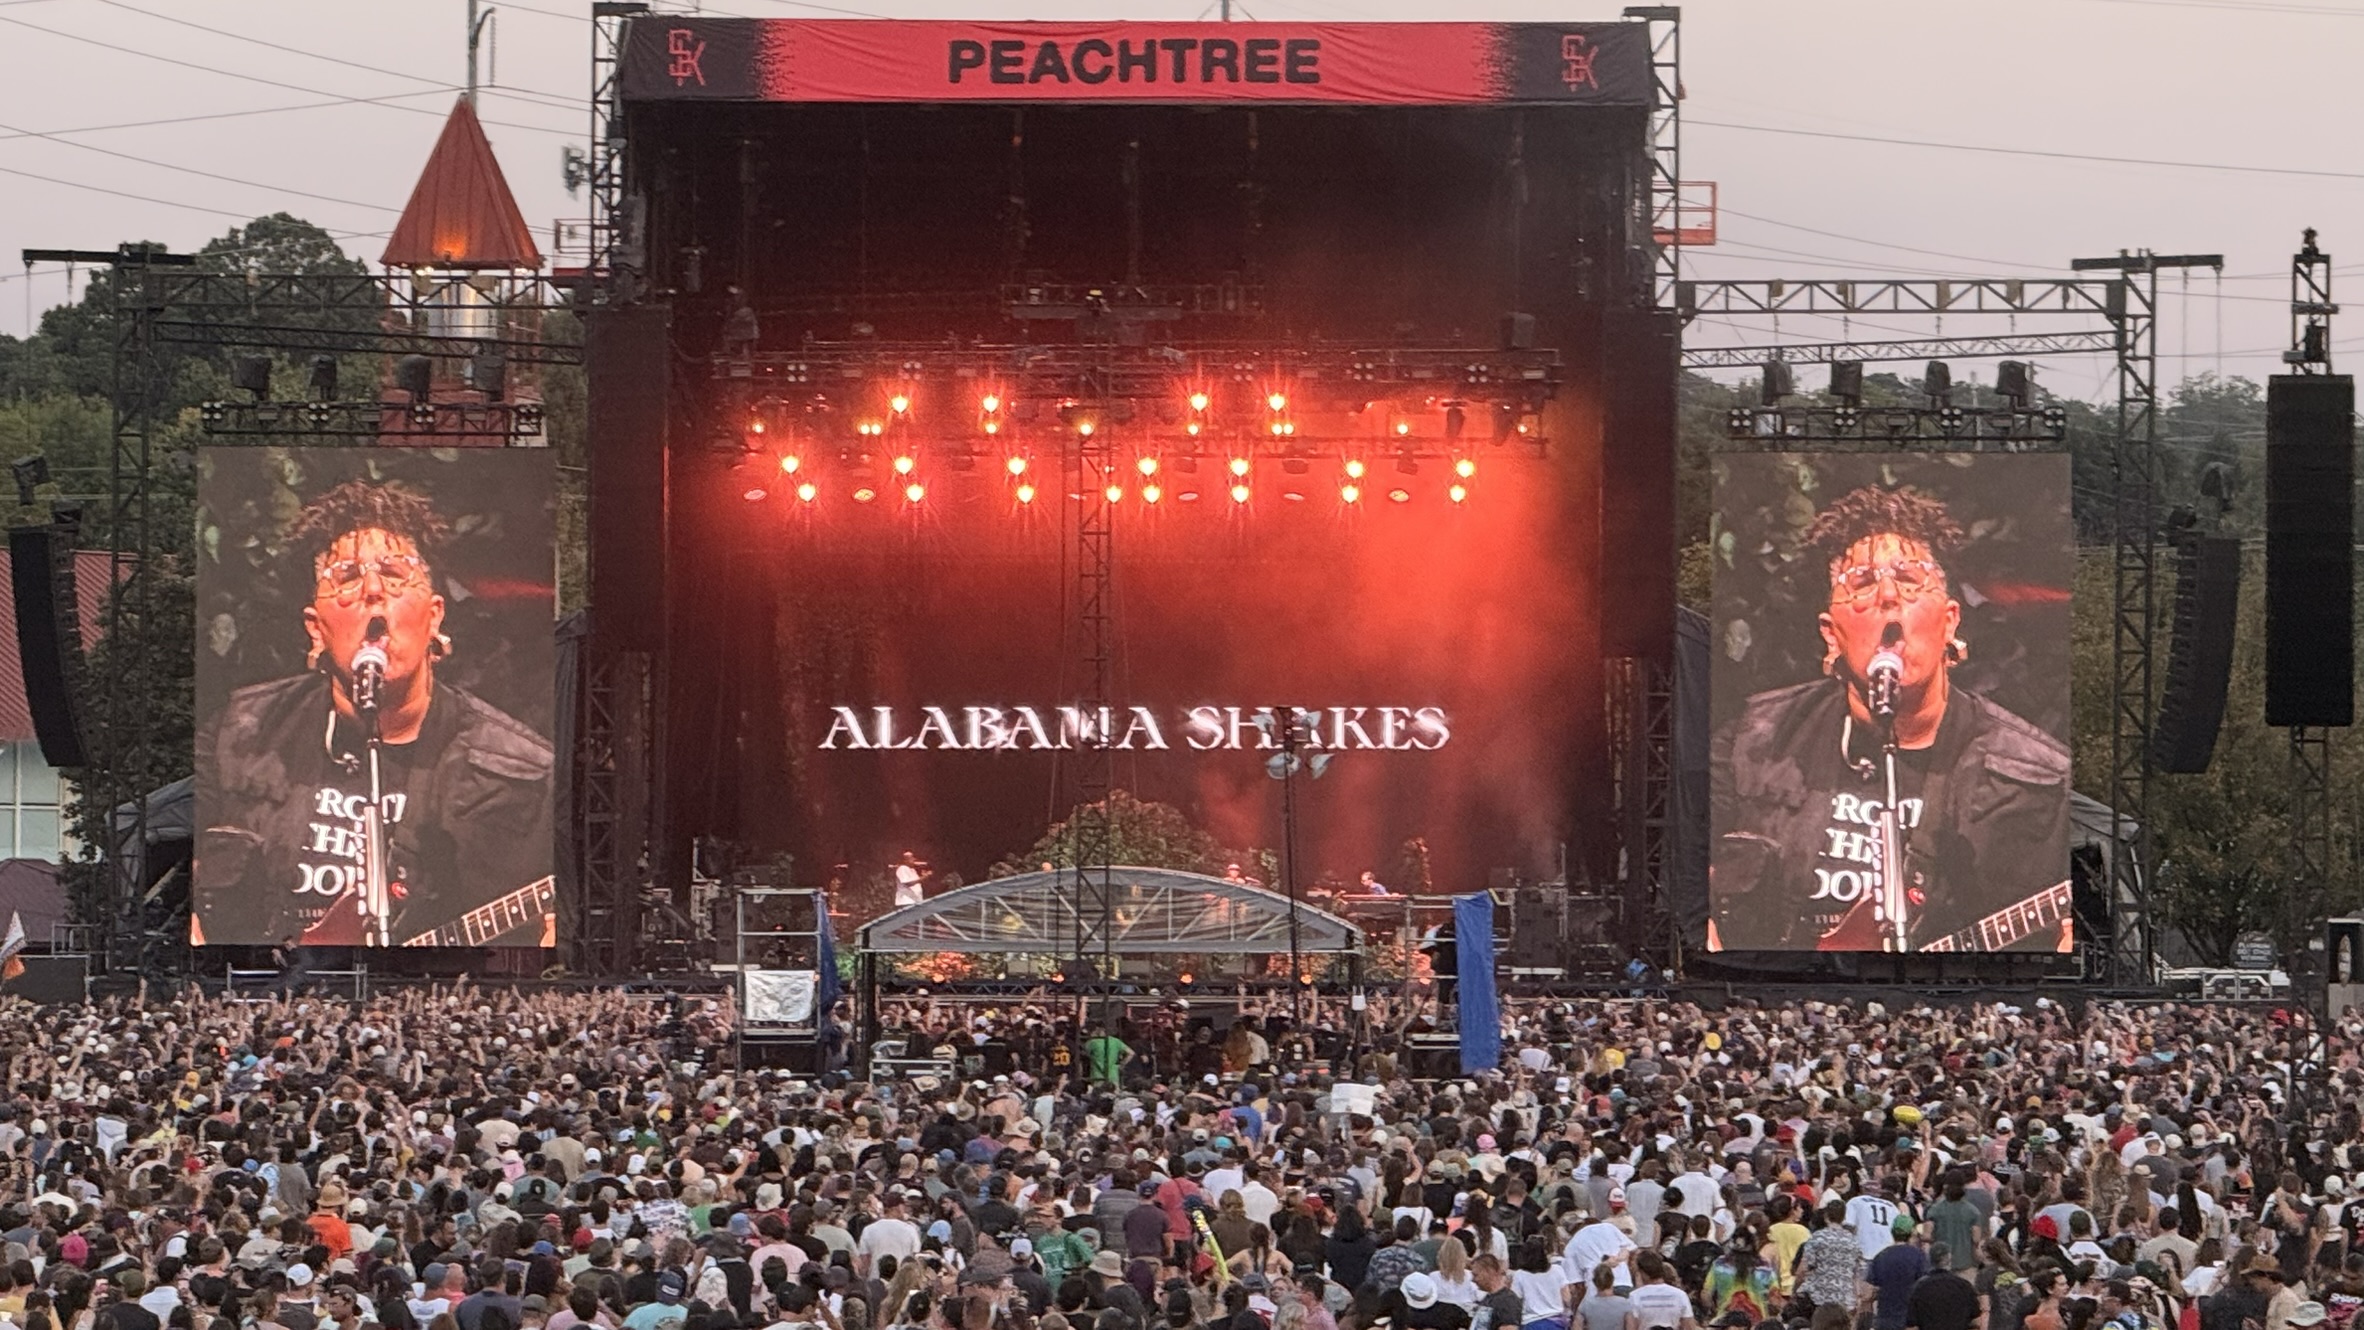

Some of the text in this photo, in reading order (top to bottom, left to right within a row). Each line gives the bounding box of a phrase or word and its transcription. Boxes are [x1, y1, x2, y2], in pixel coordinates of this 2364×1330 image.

[948, 39, 1321, 84] PEACHTREE
[819, 706, 1169, 750] ALABAMA
[1870, 1204, 1889, 1226] 11
